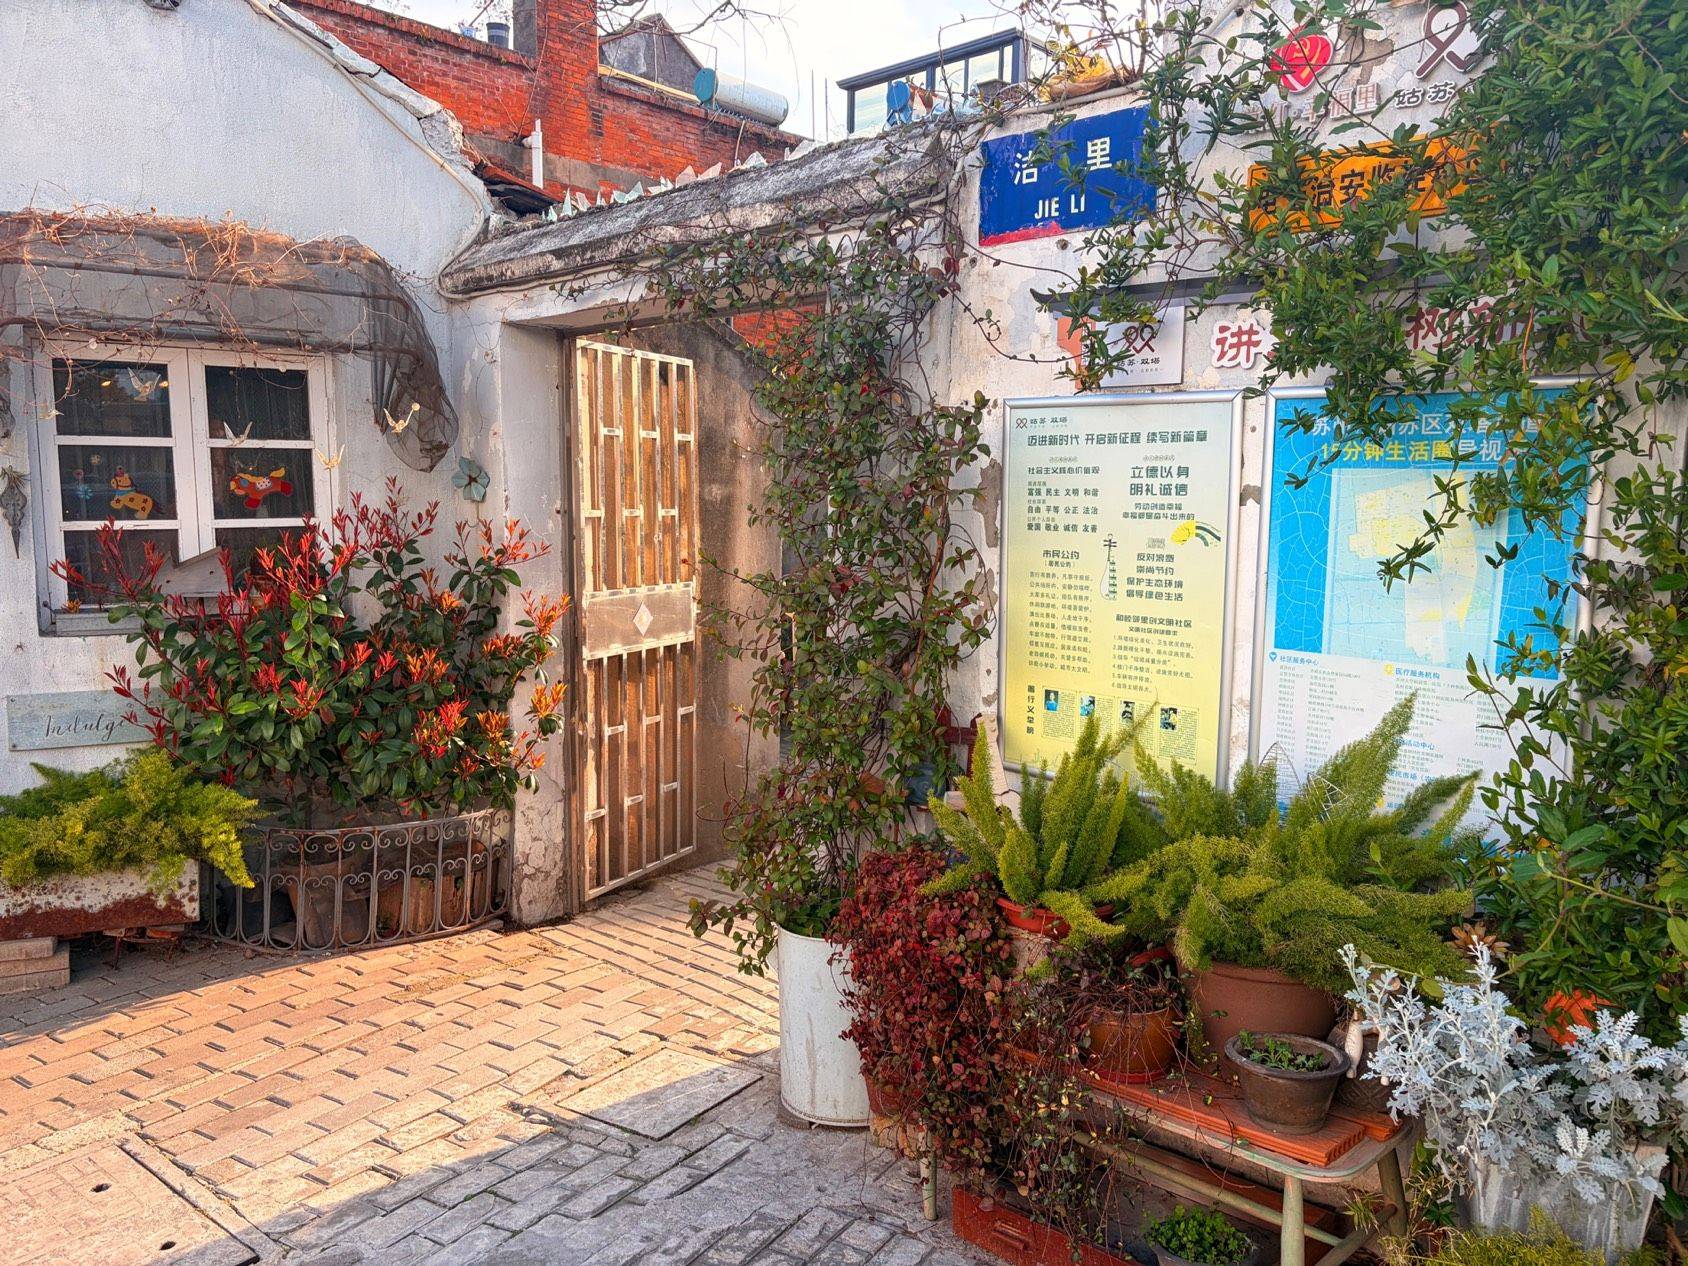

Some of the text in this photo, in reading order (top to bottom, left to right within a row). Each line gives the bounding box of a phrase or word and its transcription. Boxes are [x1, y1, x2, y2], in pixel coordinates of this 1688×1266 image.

[1397, 82, 1454, 107] 姑苏
[1034, 194, 1085, 219] JIE LI
[1028, 430, 1207, 446] 迈进新时代 开启新征程 续写新篇章
[1028, 466, 1100, 474] 社会主义核心价值观
[1028, 488, 1099, 497] 富强 民主 文明 和谐
[1130, 483, 1188, 496] 明礼诚信
[1046, 506, 1059, 514] 平等
[1064, 506, 1078, 514] 公正
[1083, 507, 1098, 515] 法治
[1027, 523, 1041, 531] 爱国
[1045, 524, 1059, 532] 敬业
[1064, 524, 1078, 532] 诚信
[1043, 550, 1079, 559] 市民公约
[1137, 566, 1174, 575] 崇尚节约
[1127, 577, 1183, 588] 保护生态环境
[1395, 667, 1440, 679] 医疗服务机构
